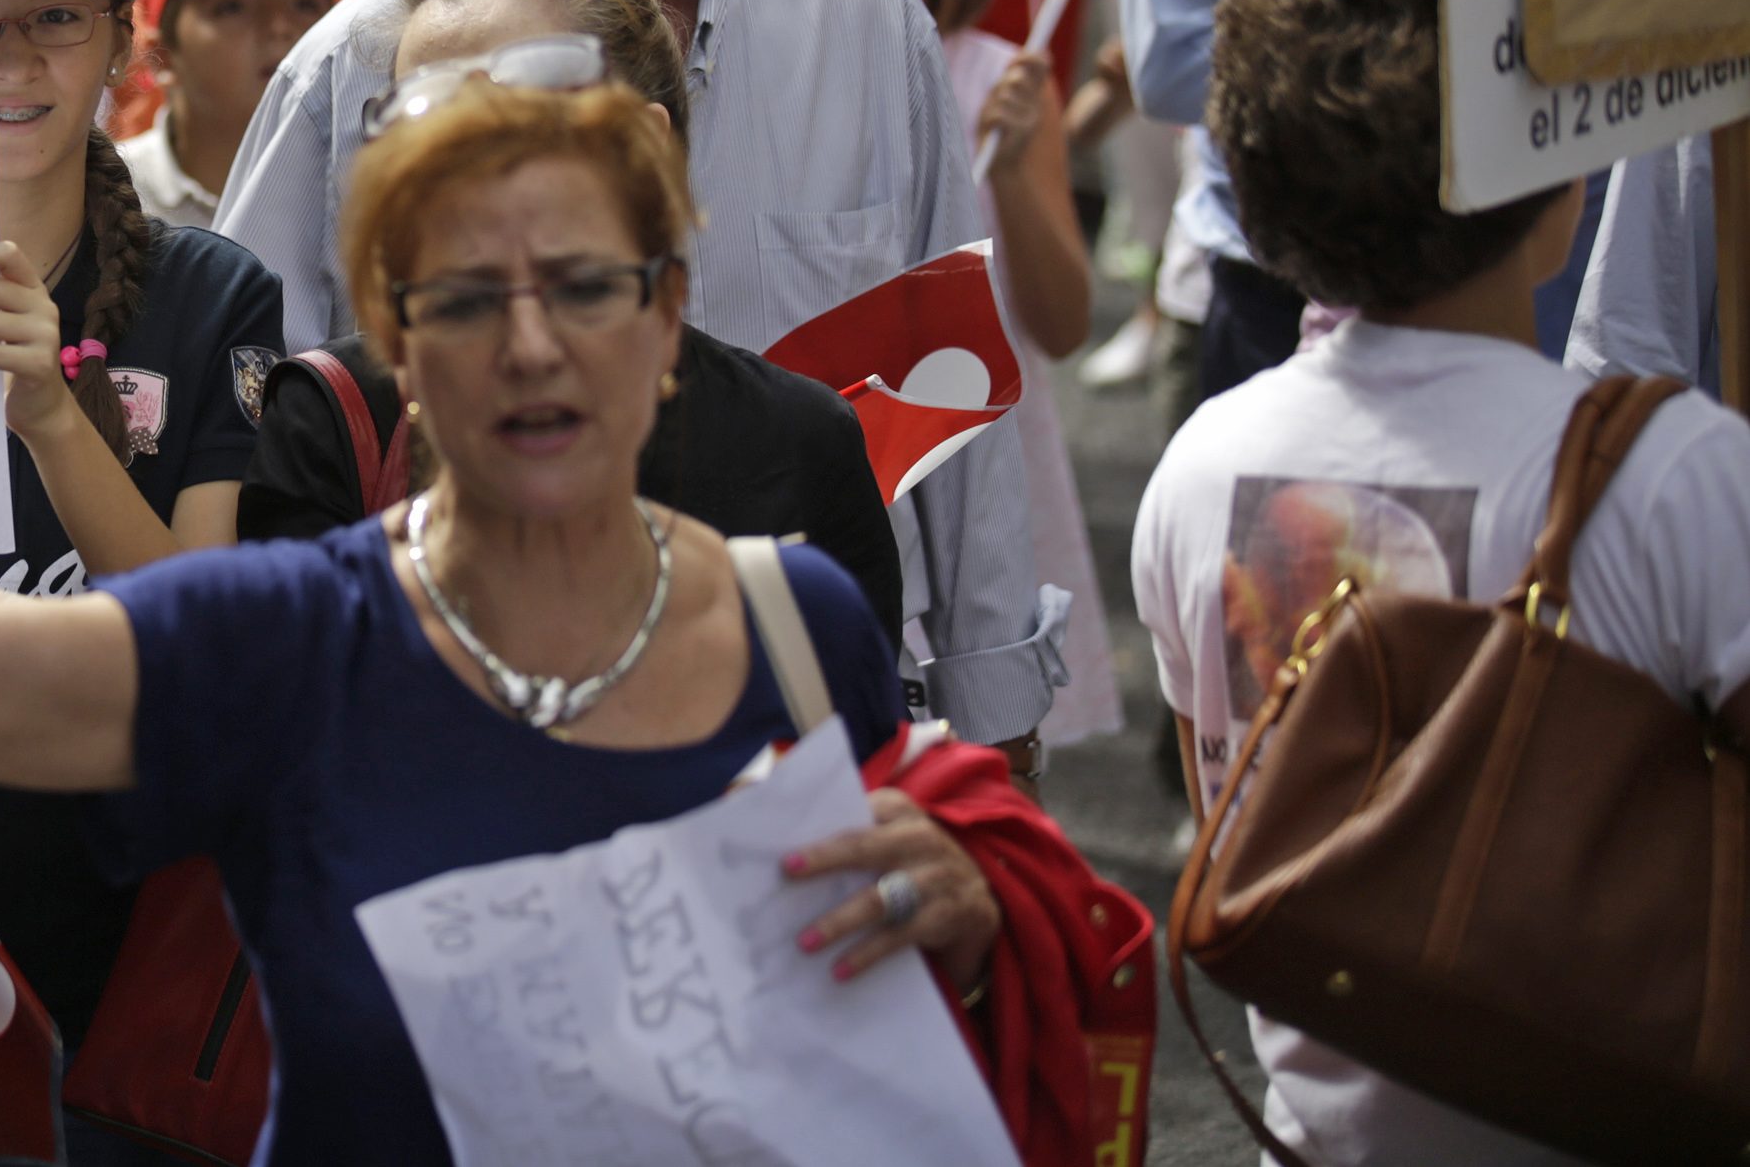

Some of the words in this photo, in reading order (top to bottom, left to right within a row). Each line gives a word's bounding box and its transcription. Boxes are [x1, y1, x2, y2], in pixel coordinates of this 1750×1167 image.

[1530, 88, 1560, 150] el
[1572, 83, 1593, 137] 2
[1604, 76, 1644, 126] de
